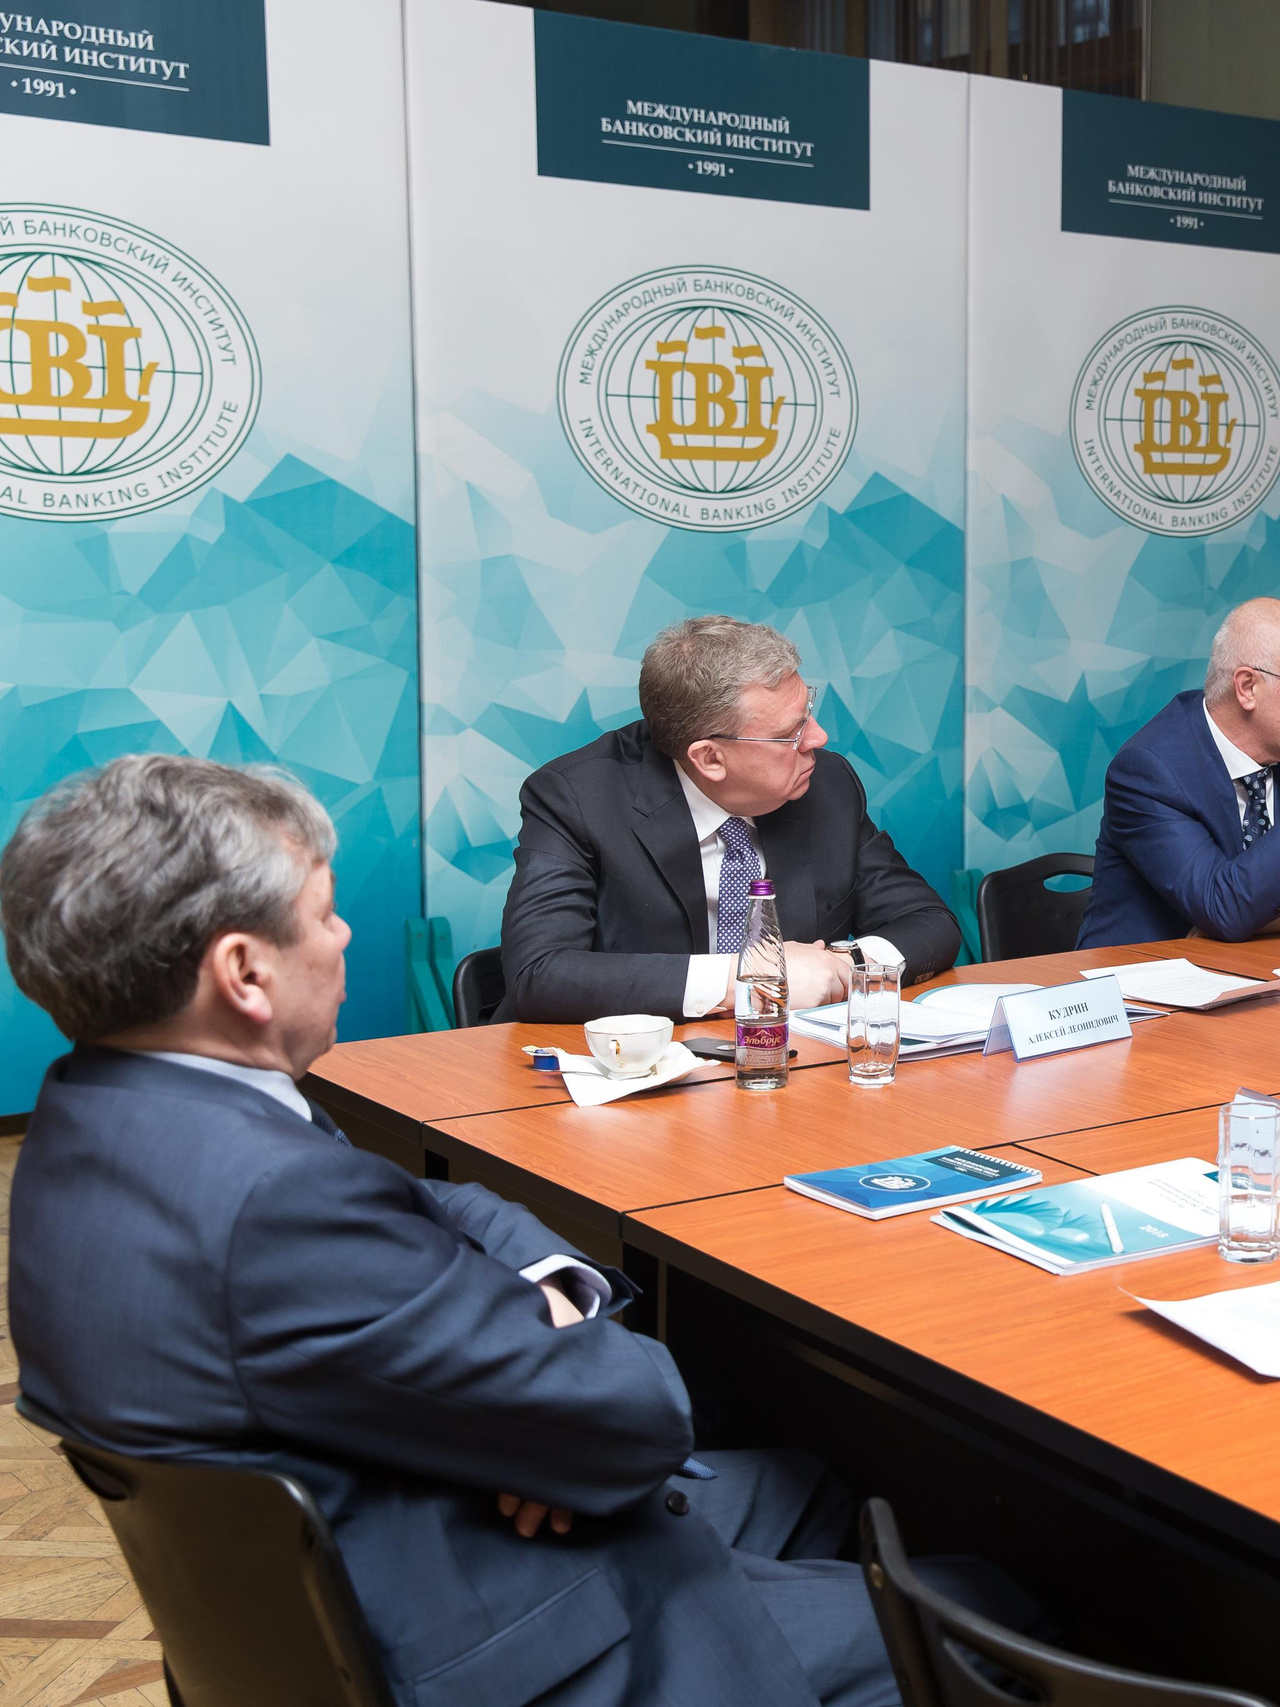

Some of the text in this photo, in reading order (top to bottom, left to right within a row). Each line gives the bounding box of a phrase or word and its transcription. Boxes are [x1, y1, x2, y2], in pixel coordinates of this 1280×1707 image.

[63, 46, 190, 81] ИНСТИТУТ
[21, 77, 66, 99] 1991
[626, 99, 790, 134] МЕЖДУНАРОДНЫЙ
[600, 117, 815, 158] БАНКОВСКИЙ ИНСТИТУТ
[695, 160, 727, 177] 1991
[1127, 164, 1247, 191] МЕЖДУНАРОДНЫЙ
[1107, 180, 1264, 213] БАНКОВСКИЙ ИНСТИТУТ
[1176, 215, 1198, 229] 1991
[24, 219, 171, 275] БАНКОВСКИЙ
[171, 271, 237, 367] ИНСТИТУТ
[579, 277, 841, 398] МЕЖДУНАРОДНЫЙ БАНКОВСКИЙ ИНСТИТУТ
[1085, 316, 1279, 420] МЕЖДУНАРОДНЫЙ БАНКОВСКИЙ ИНСТИТУТ
[43, 482, 150, 508] BANKING
[158, 400, 239, 489] INSTITUTE
[579, 417, 842, 521] INTERNATIONAL BANKING INSTITUTE
[1084, 438, 1278, 527] INTERNATIONAL BANKING INSTITUTE
[1048, 1002, 1089, 1020] КУДРИН
[743, 1034, 781, 1047] Эльбрус
[1028, 1014, 1119, 1044] АЛЕКСЕЙ ЛЕОНИДОВИЧ
